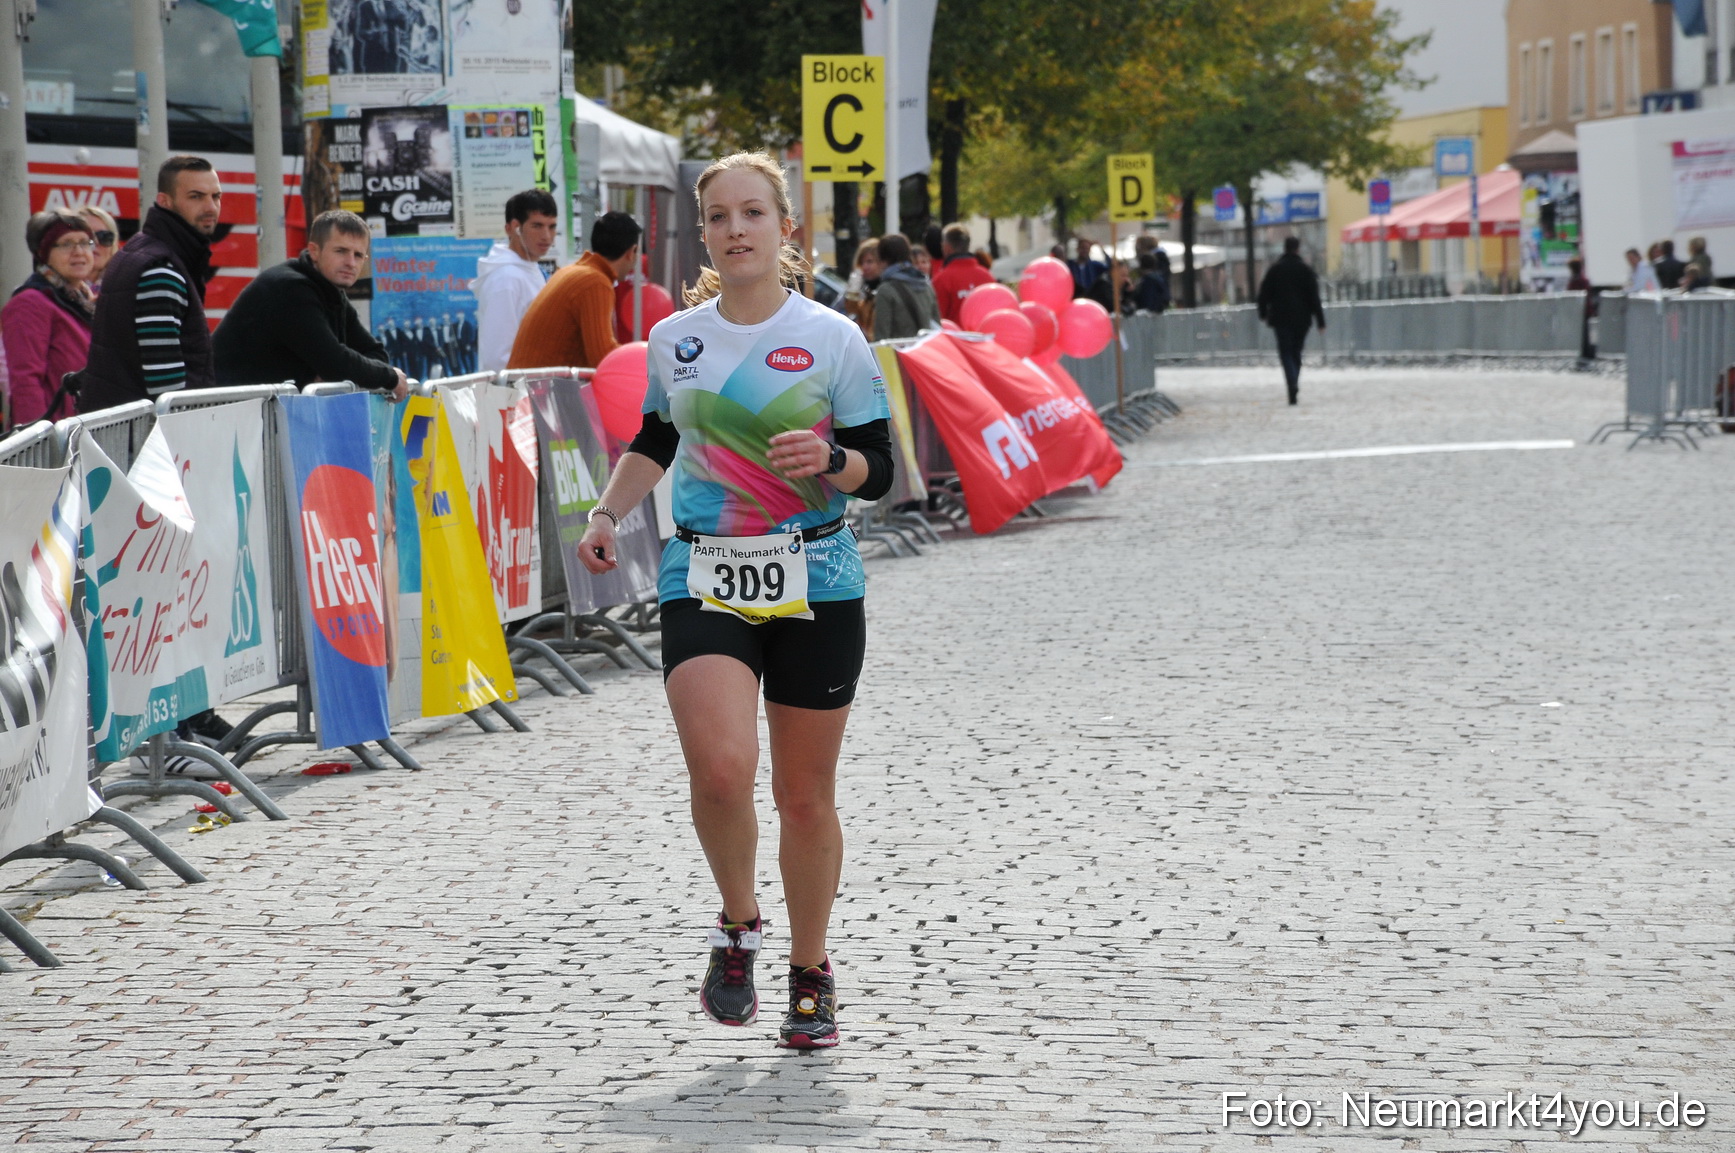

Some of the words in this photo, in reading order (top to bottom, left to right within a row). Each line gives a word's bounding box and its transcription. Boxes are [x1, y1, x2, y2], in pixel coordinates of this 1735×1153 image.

[813, 61, 875, 83] Block
[824, 93, 864, 155] C
[1113, 158, 1147, 170] Block
[366, 176, 420, 192] CASH
[1121, 175, 1142, 206] D
[392, 193, 452, 221] Cocaine
[375, 257, 437, 273] Winter
[772, 353, 809, 366] Hervis
[673, 367, 699, 377] PARTL
[673, 373, 699, 383] Neumarkt
[693, 546, 728, 558] PARTL
[730, 546, 785, 558] Neumarkt
[803, 539, 838, 550] markter
[805, 551, 830, 562] tlauf
[302, 511, 384, 625] Hervi
[713, 562, 785, 602] 309
